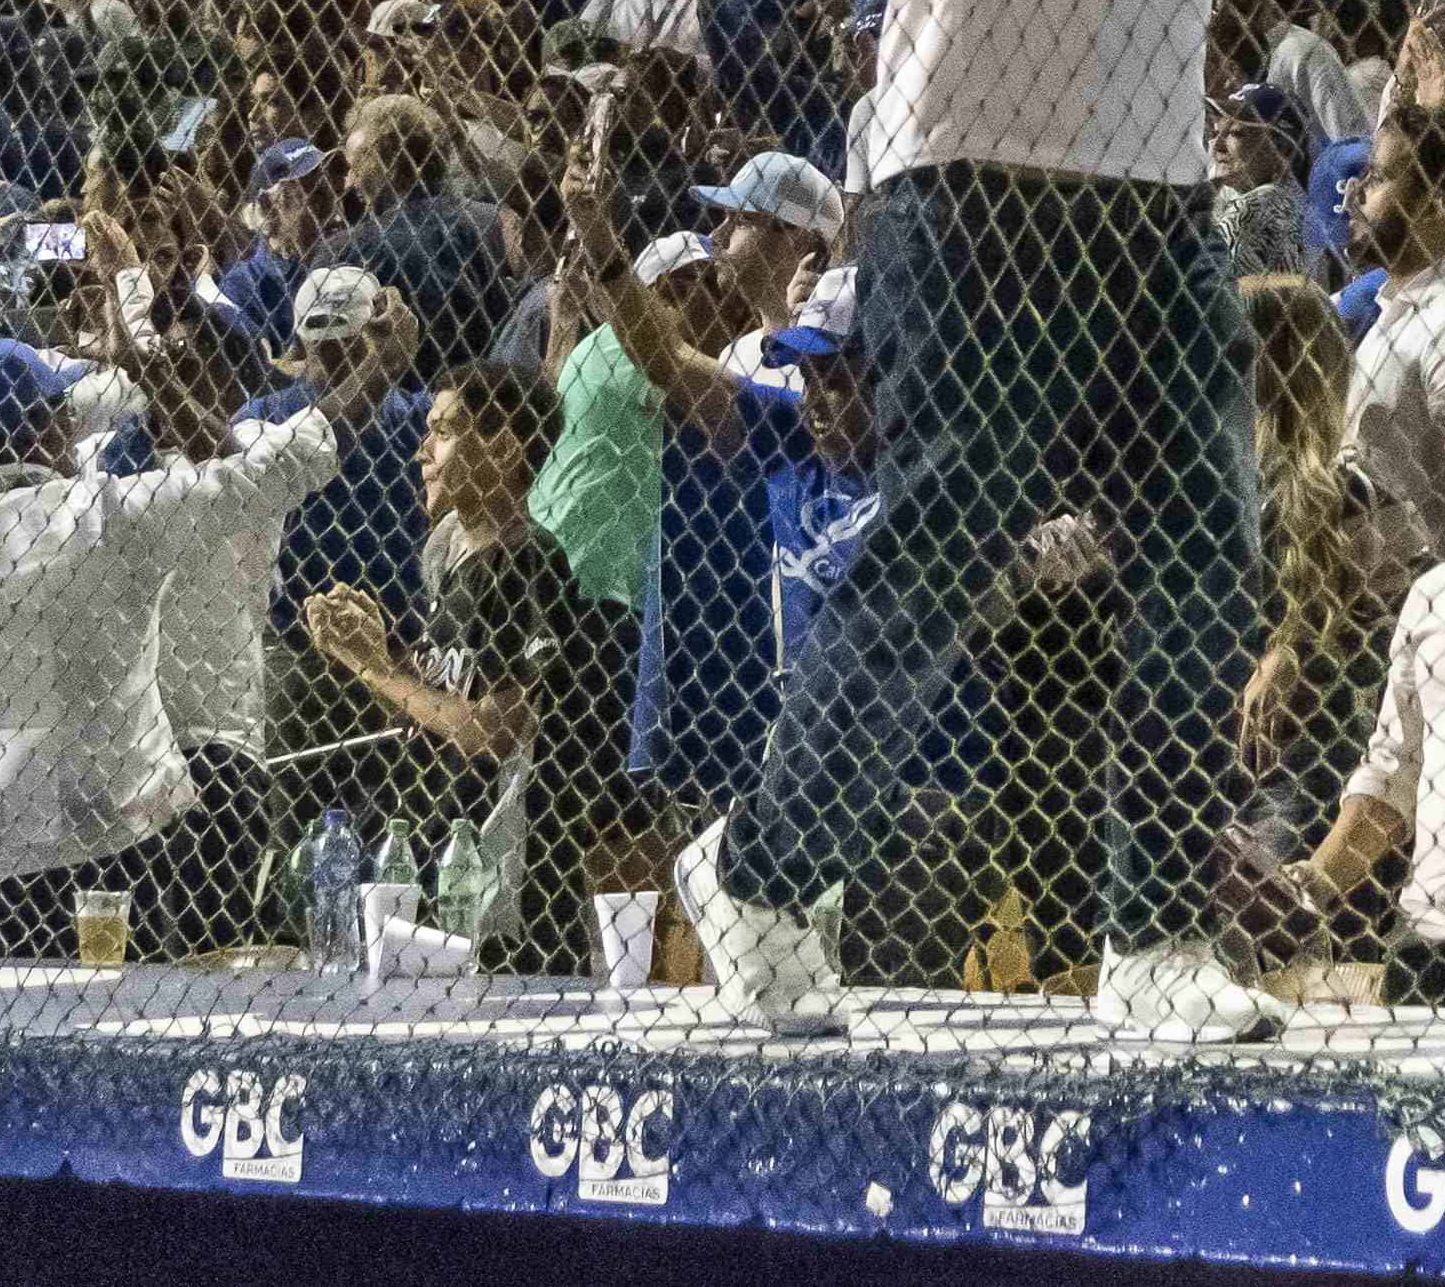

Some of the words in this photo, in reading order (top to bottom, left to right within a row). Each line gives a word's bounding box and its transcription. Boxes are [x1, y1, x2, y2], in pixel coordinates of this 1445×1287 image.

[180, 1069, 307, 1159] GBC
[529, 1083, 673, 1181] GBC
[233, 1163, 296, 1179] FARMACIAS
[928, 1102, 1091, 1207] GBC
[591, 1183, 661, 1202] FARMACIAS
[998, 1208, 1077, 1231] FARMACIAS
